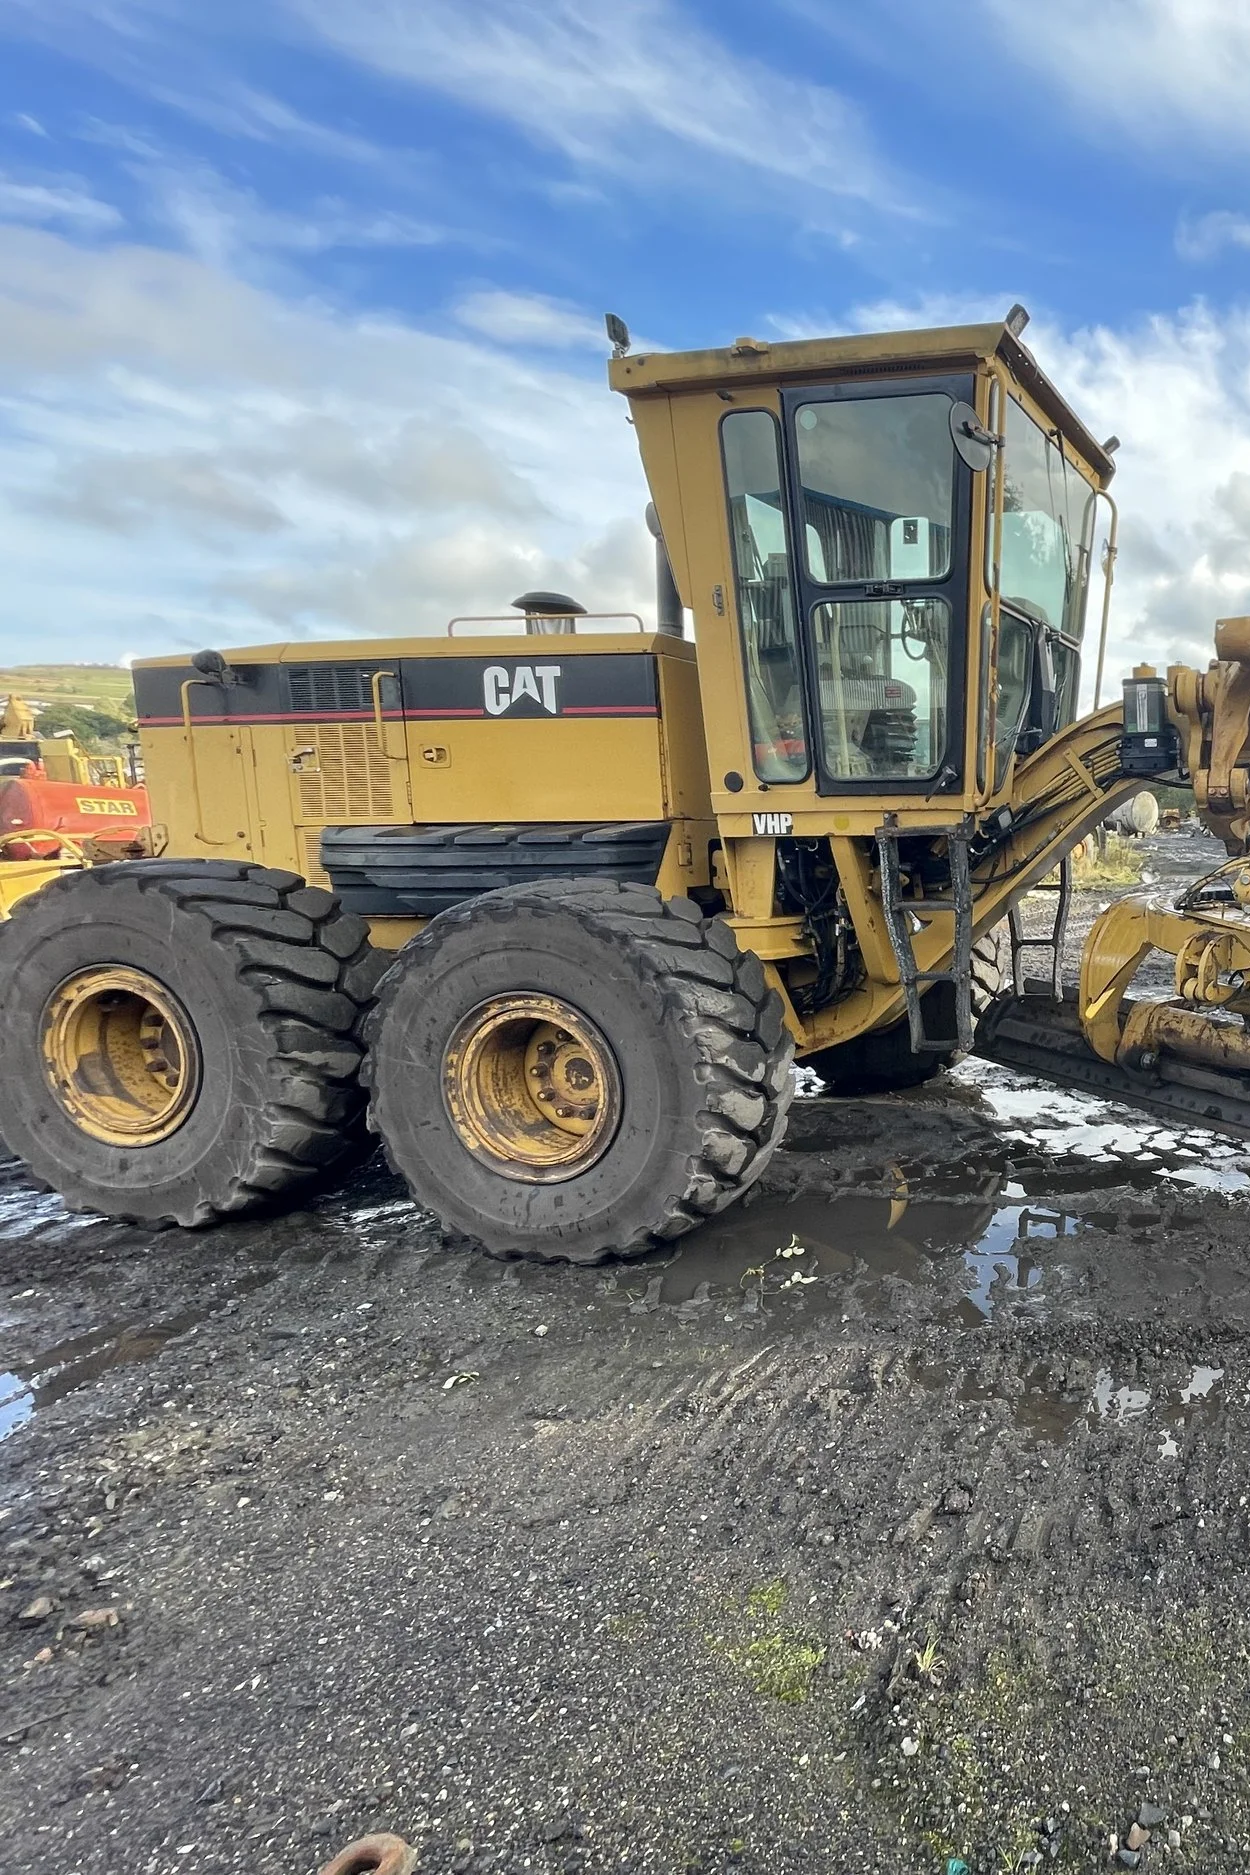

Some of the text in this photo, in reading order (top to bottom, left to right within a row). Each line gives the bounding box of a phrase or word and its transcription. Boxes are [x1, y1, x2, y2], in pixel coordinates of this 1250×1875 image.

[483, 665, 561, 716] CAT
[80, 799, 135, 814] STAR
[752, 813, 793, 835] VHP
